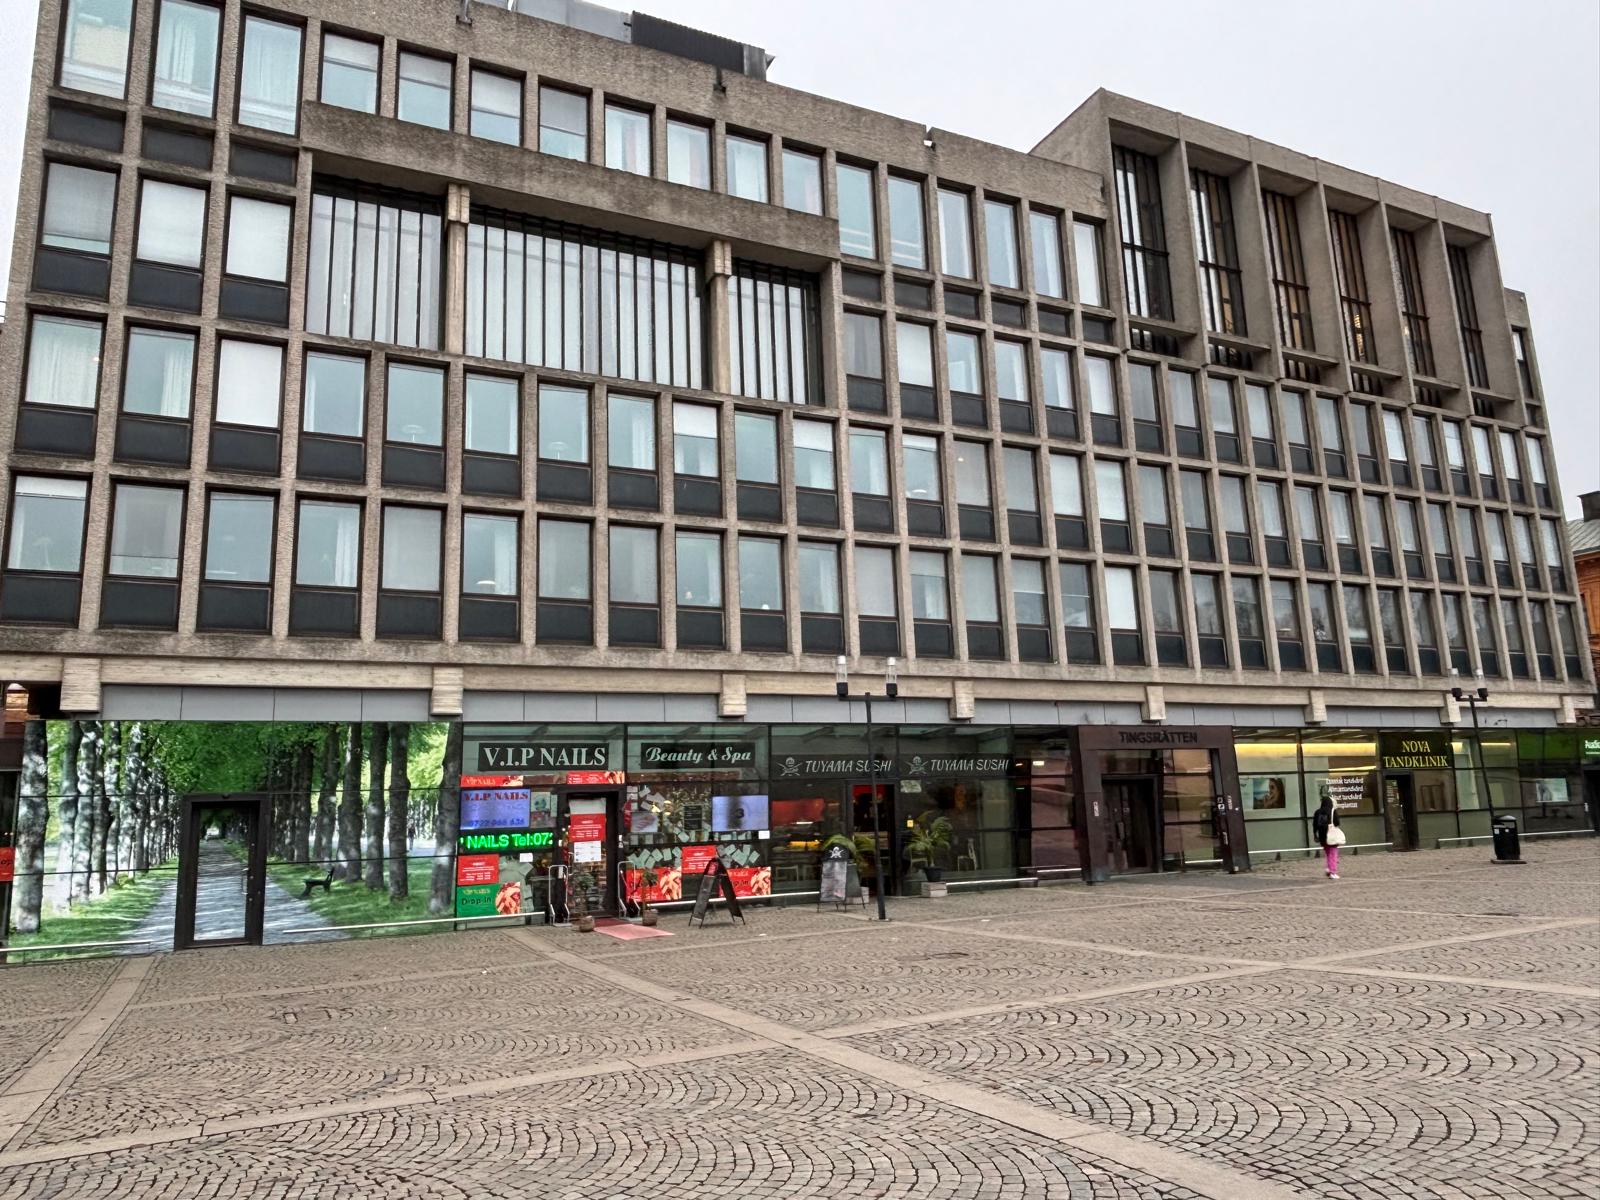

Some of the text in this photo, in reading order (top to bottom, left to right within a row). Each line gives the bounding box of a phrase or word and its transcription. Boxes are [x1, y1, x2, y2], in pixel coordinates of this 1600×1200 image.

[1118, 730, 1198, 744] TINGSRÄTTEN
[1402, 741, 1431, 753] NOVA
[483, 747, 606, 767] V.I.P NAILS
[645, 746, 752, 764] Beauty & Spa
[1383, 755, 1449, 768] TANDKLINIK
[805, 759, 892, 773] TUYAMA SUSHI
[930, 758, 1010, 771] TUYAMA SUSHI
[494, 791, 529, 801] NAILS
[467, 834, 510, 849] NAILS
